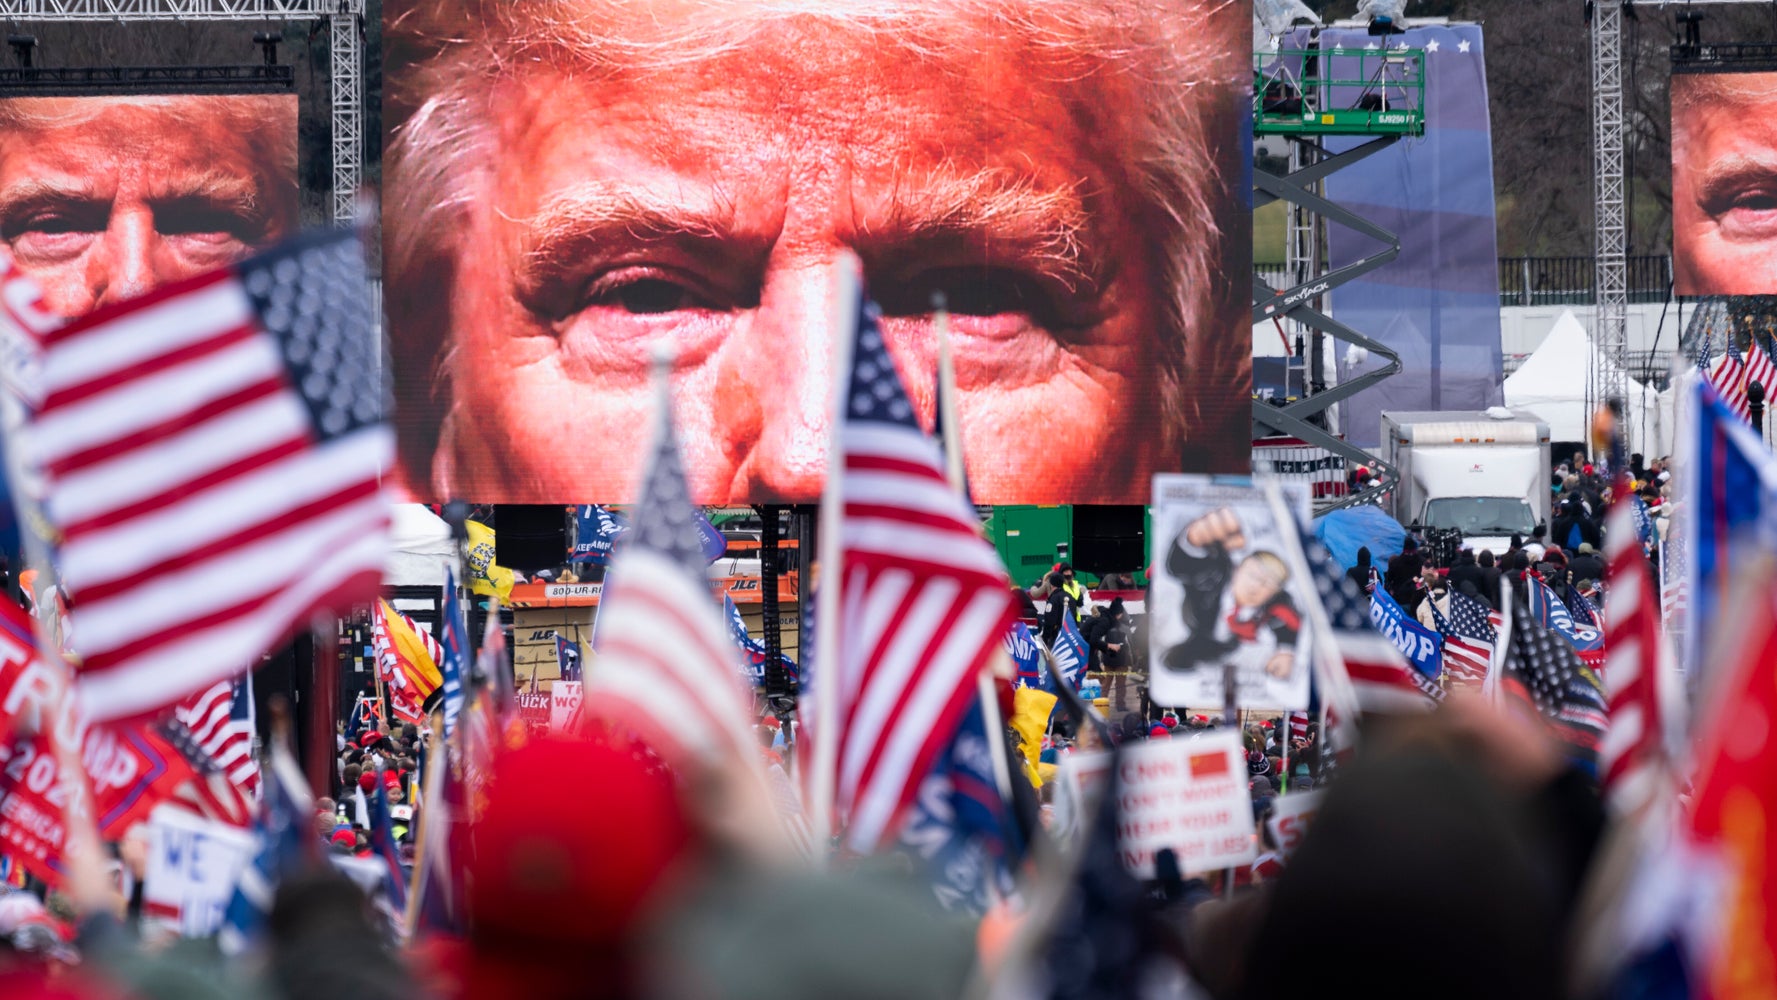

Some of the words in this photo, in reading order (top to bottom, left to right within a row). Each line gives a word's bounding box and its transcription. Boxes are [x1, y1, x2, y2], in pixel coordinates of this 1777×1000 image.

[1284, 281, 1329, 305] SKYJACK
[552, 586, 601, 596] 800-UR-R
[731, 580, 757, 591] JLG
[0, 790, 64, 847] ERICA
